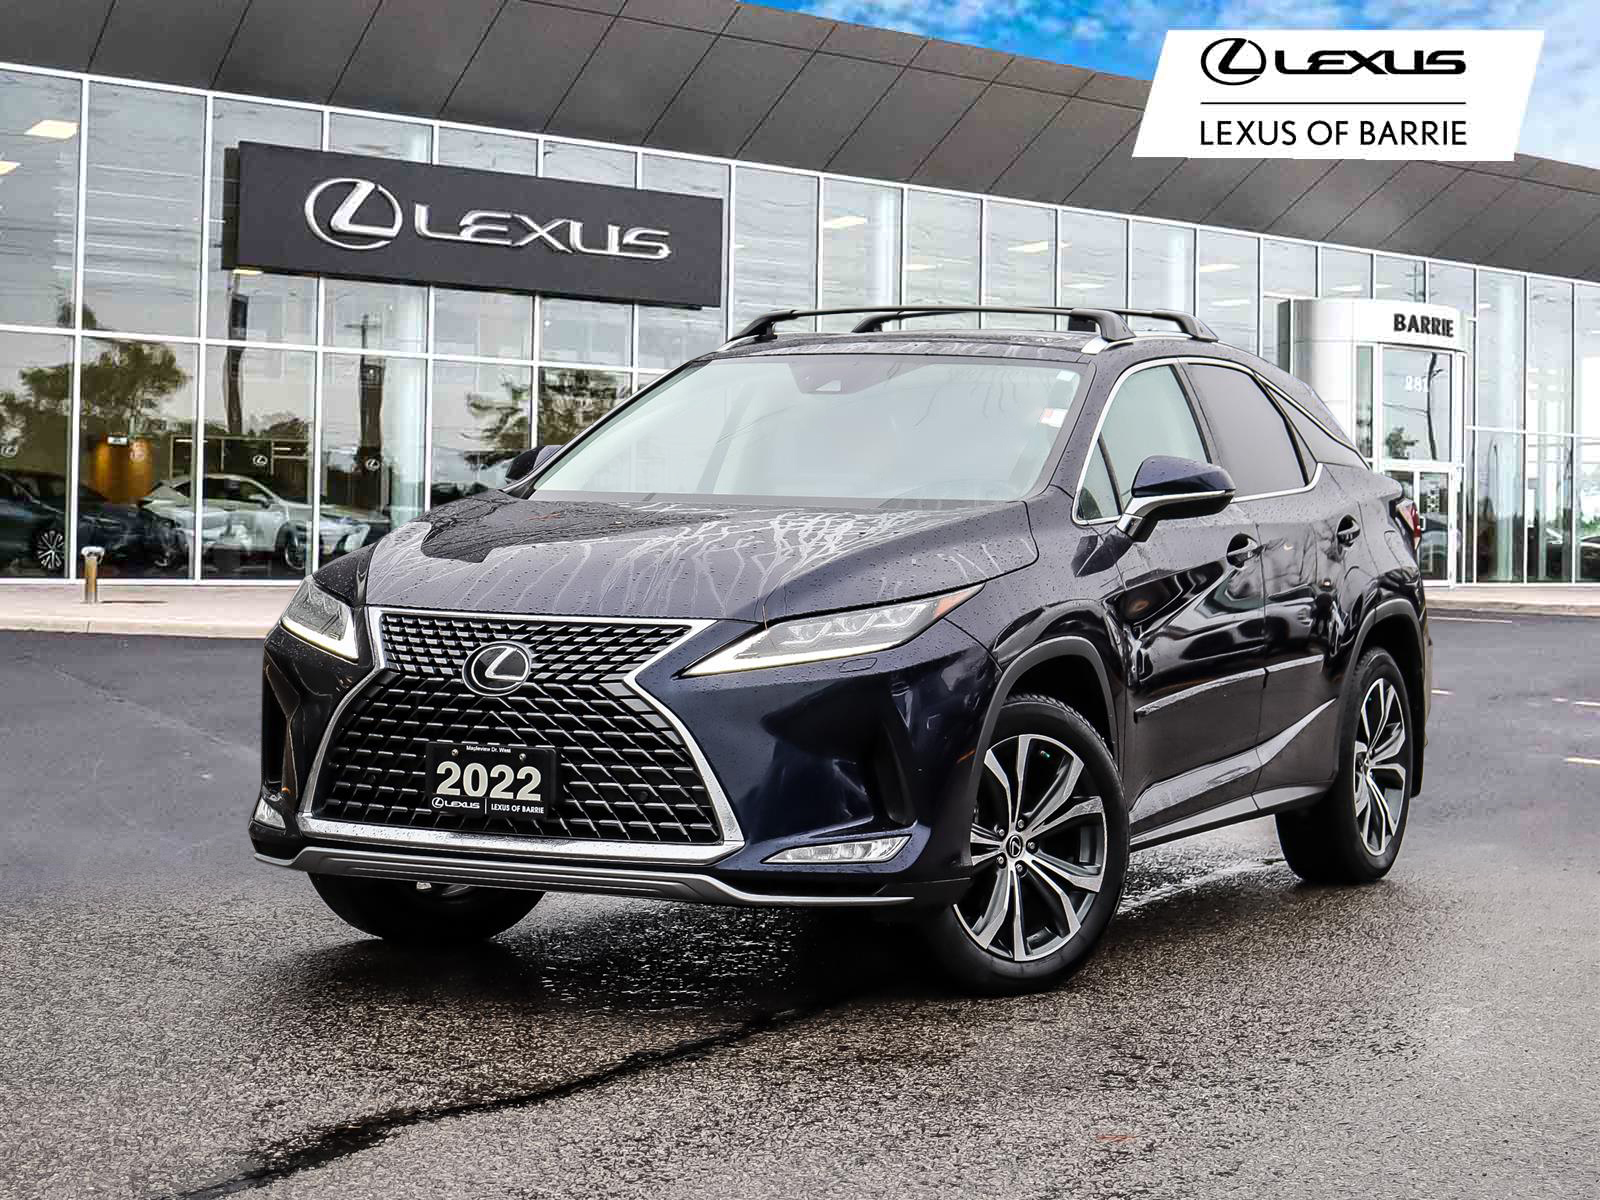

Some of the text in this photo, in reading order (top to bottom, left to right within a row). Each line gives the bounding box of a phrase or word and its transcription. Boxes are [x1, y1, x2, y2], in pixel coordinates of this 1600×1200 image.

[414, 203, 672, 260] LEXUS
[1393, 313, 1454, 338] BARRIE
[436, 761, 541, 801] 2022
[444, 800, 545, 814] LEXUS LEXUS OF BARRIE
